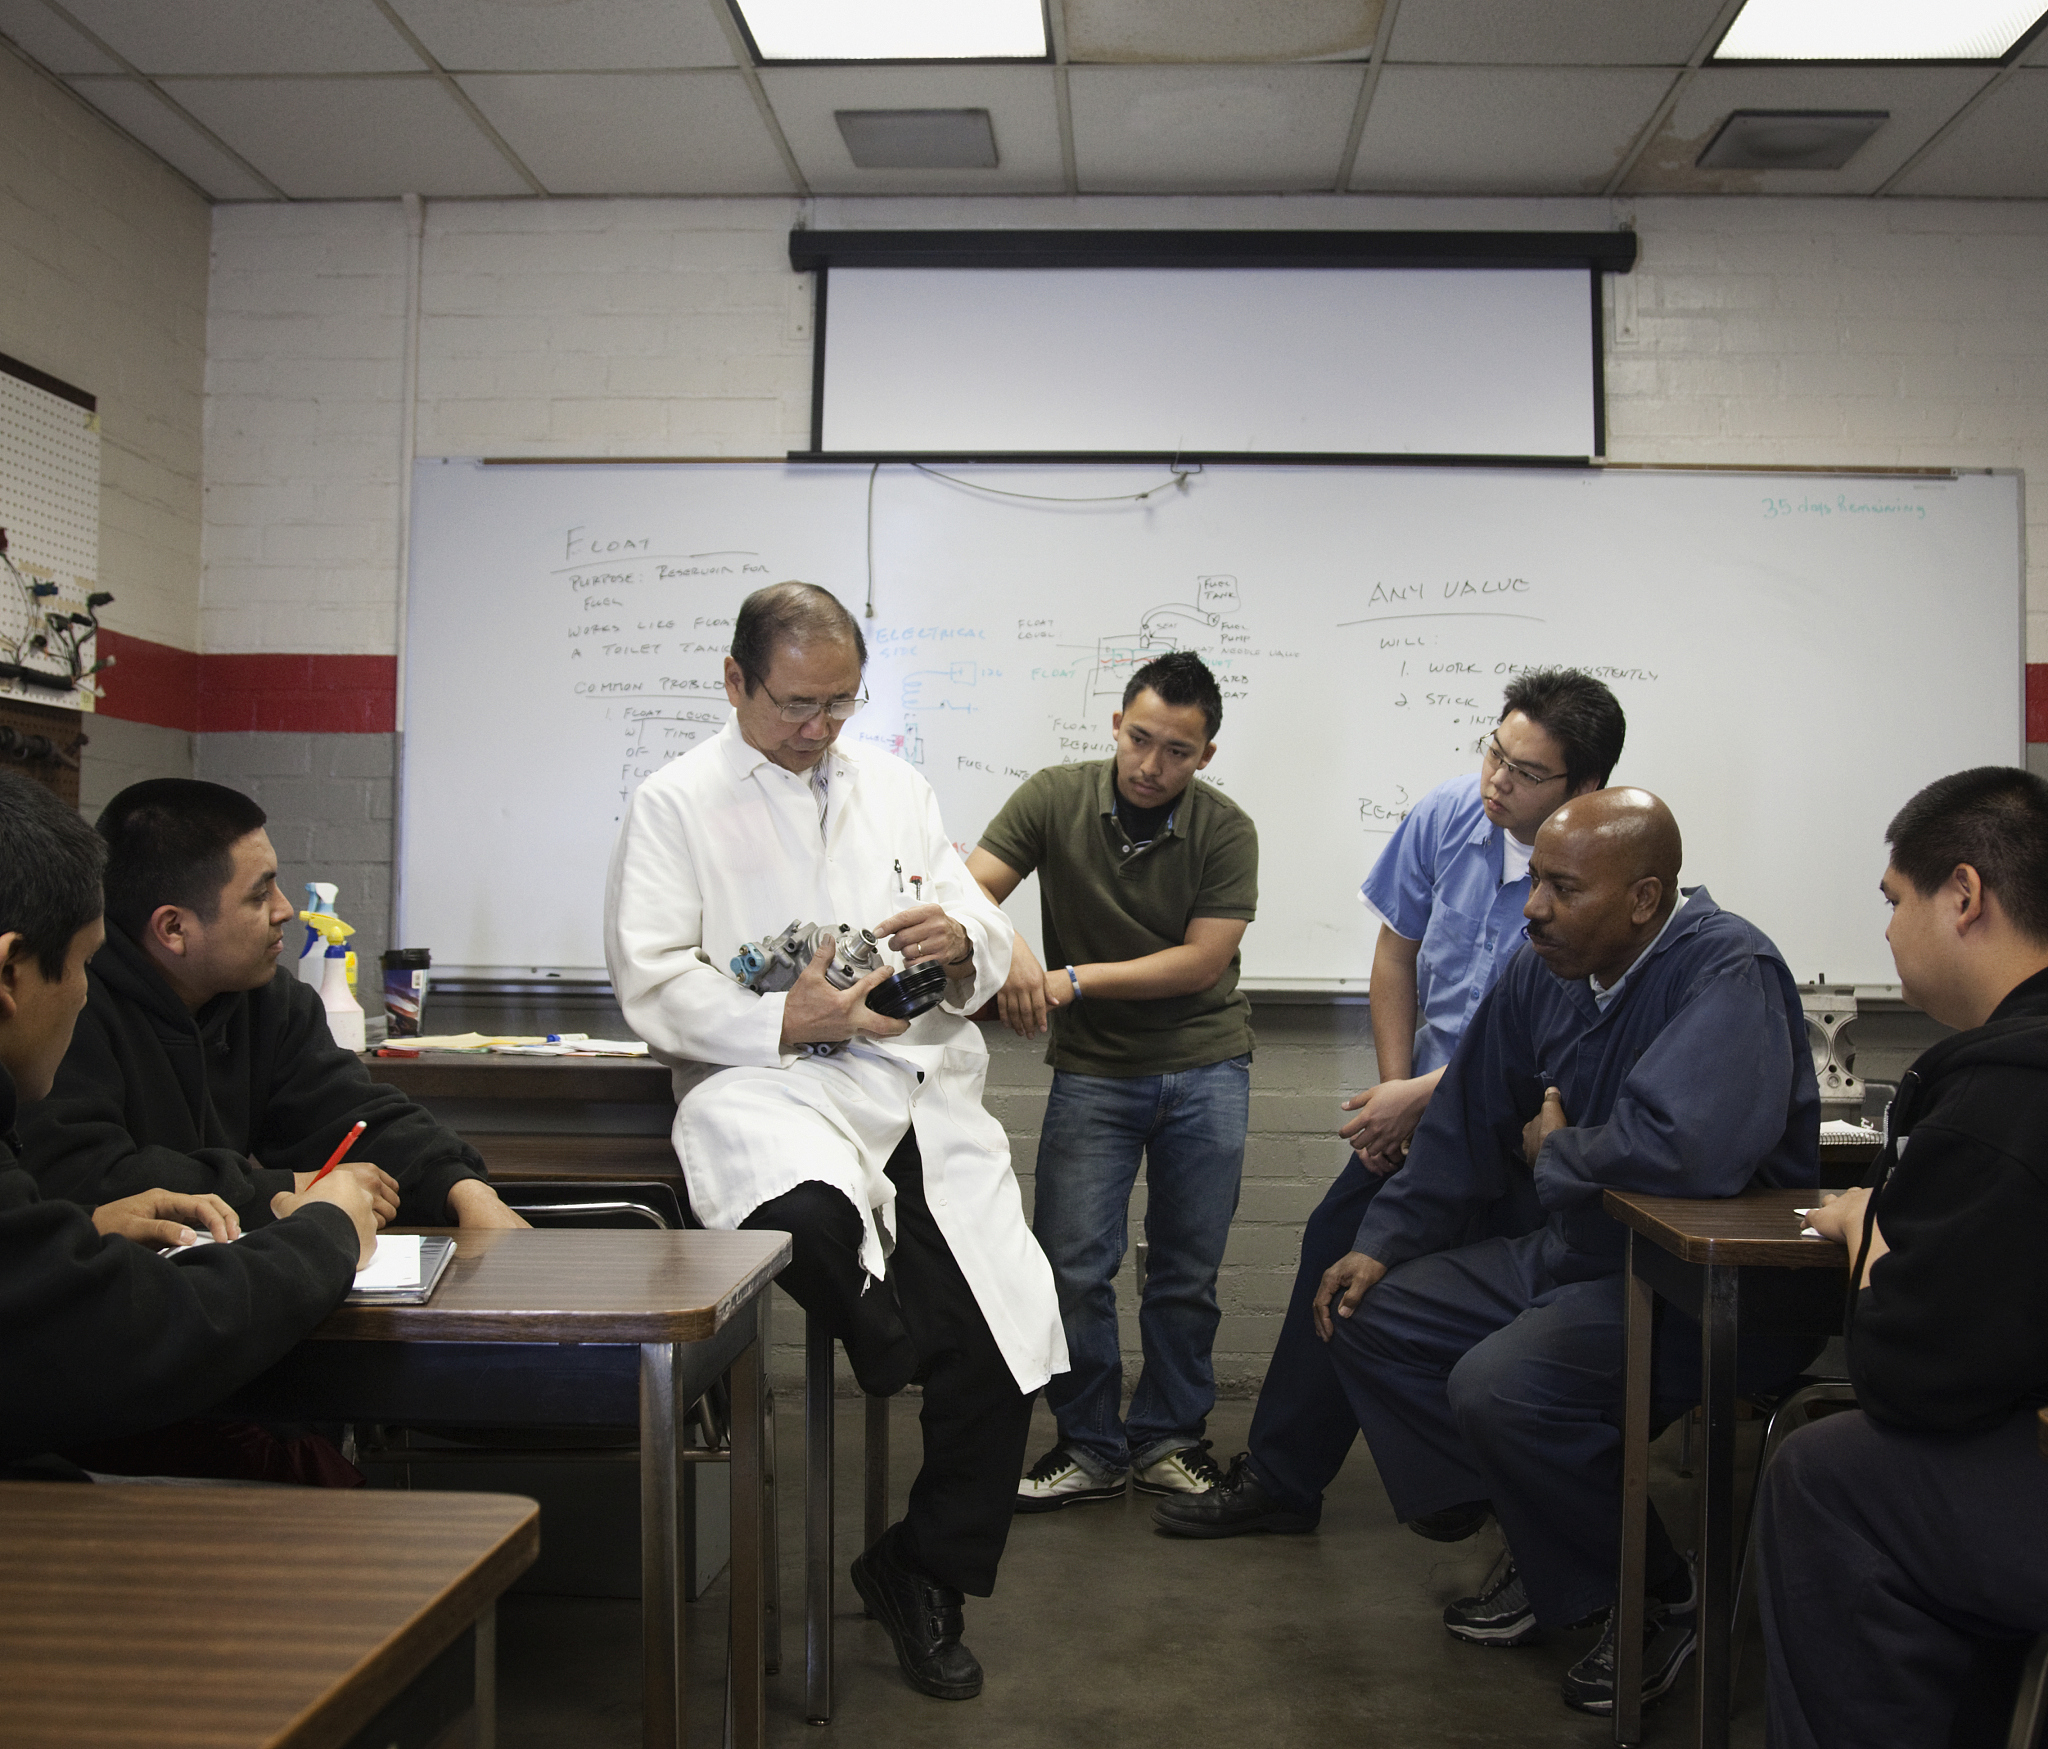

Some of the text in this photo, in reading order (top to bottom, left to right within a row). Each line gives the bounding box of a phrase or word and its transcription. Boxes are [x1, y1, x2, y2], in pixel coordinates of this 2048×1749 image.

[1762, 494, 1926, 520] 35 days Remaining
[566, 525, 650, 561] FLOAT
[742, 564, 769, 573] FOR
[1204, 578, 1231, 590] FUEL
[1204, 591, 1237, 600] TANK
[1368, 582, 1423, 607] ANY
[584, 596, 623, 611] FUEL
[568, 625, 620, 639] WORKS
[637, 620, 675, 629] LIKE
[1018, 619, 1054, 629] FLOAT
[1221, 622, 1248, 631] FUEL
[876, 626, 986, 643] ELECTRICAL
[1220, 633, 1250, 644] PUMP
[571, 642, 731, 659] A TOILET TANK
[880, 645, 917, 658] SIDE
[1032, 667, 1076, 681] FLOAT
[1429, 662, 1483, 674] WORK
[1213, 672, 1249, 684] ARB
[574, 677, 725, 694] COMMON PROBLE
[1426, 693, 1479, 707] STICK
[623, 707, 662, 719] FLOAT
[663, 727, 695, 740] TIME
[1060, 737, 1117, 753] REQUIR
[957, 756, 995, 774] FUEL
[622, 765, 659, 780] FLO
